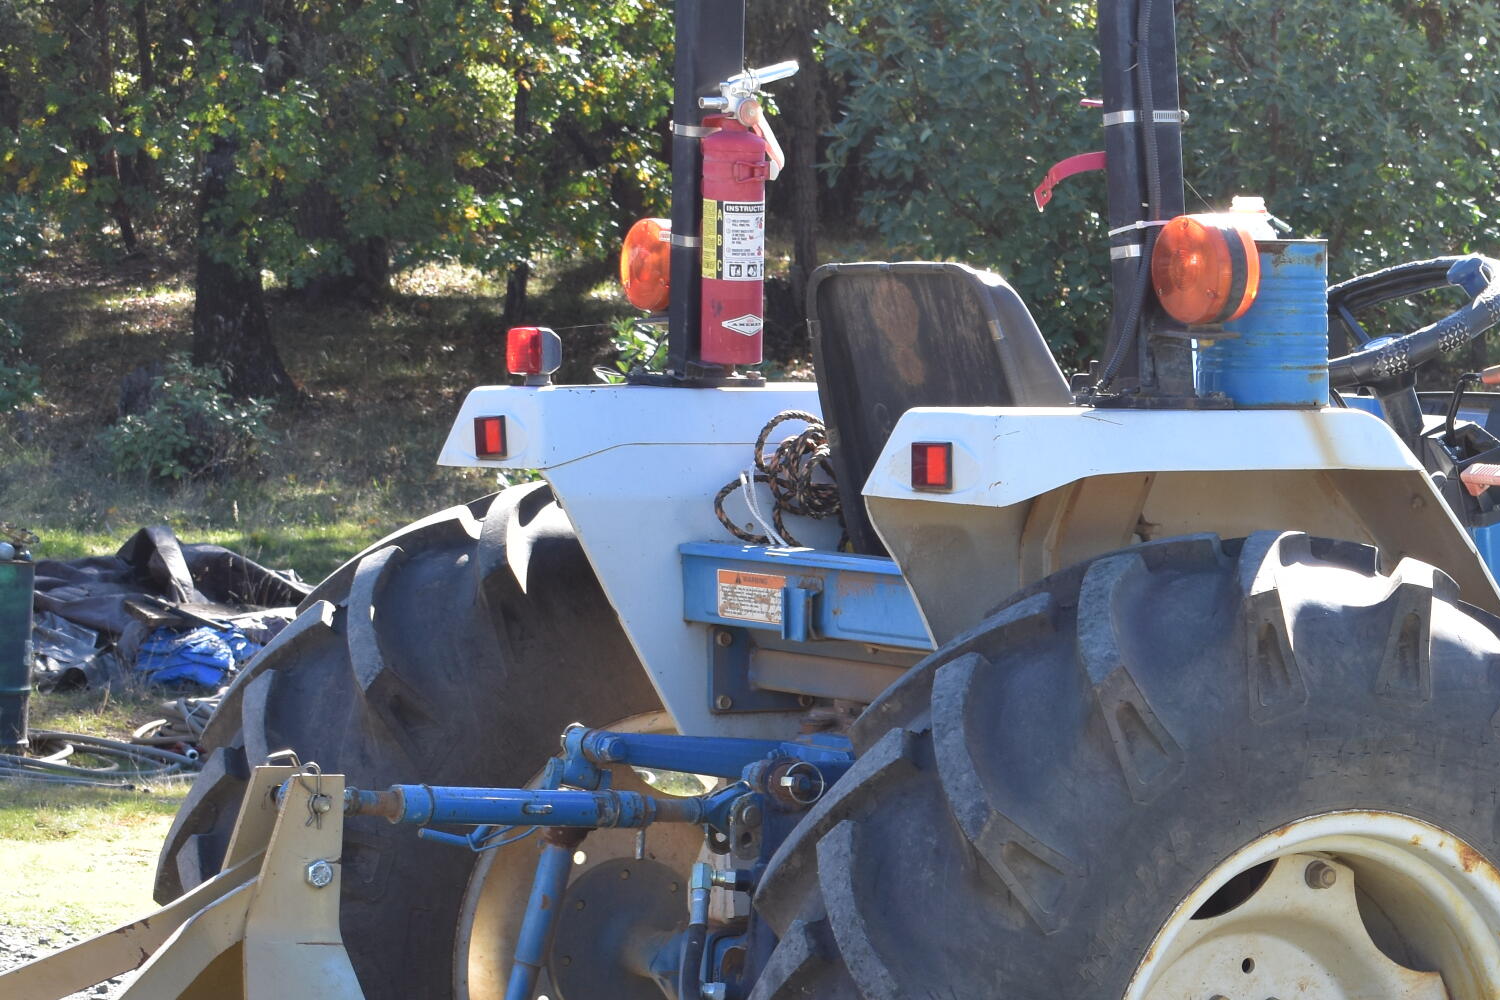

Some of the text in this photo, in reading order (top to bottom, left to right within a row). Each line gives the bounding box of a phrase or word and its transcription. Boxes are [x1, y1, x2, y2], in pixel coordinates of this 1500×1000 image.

[717, 208, 723, 221] A
[717, 234, 723, 246] B
[717, 259, 723, 272] C
